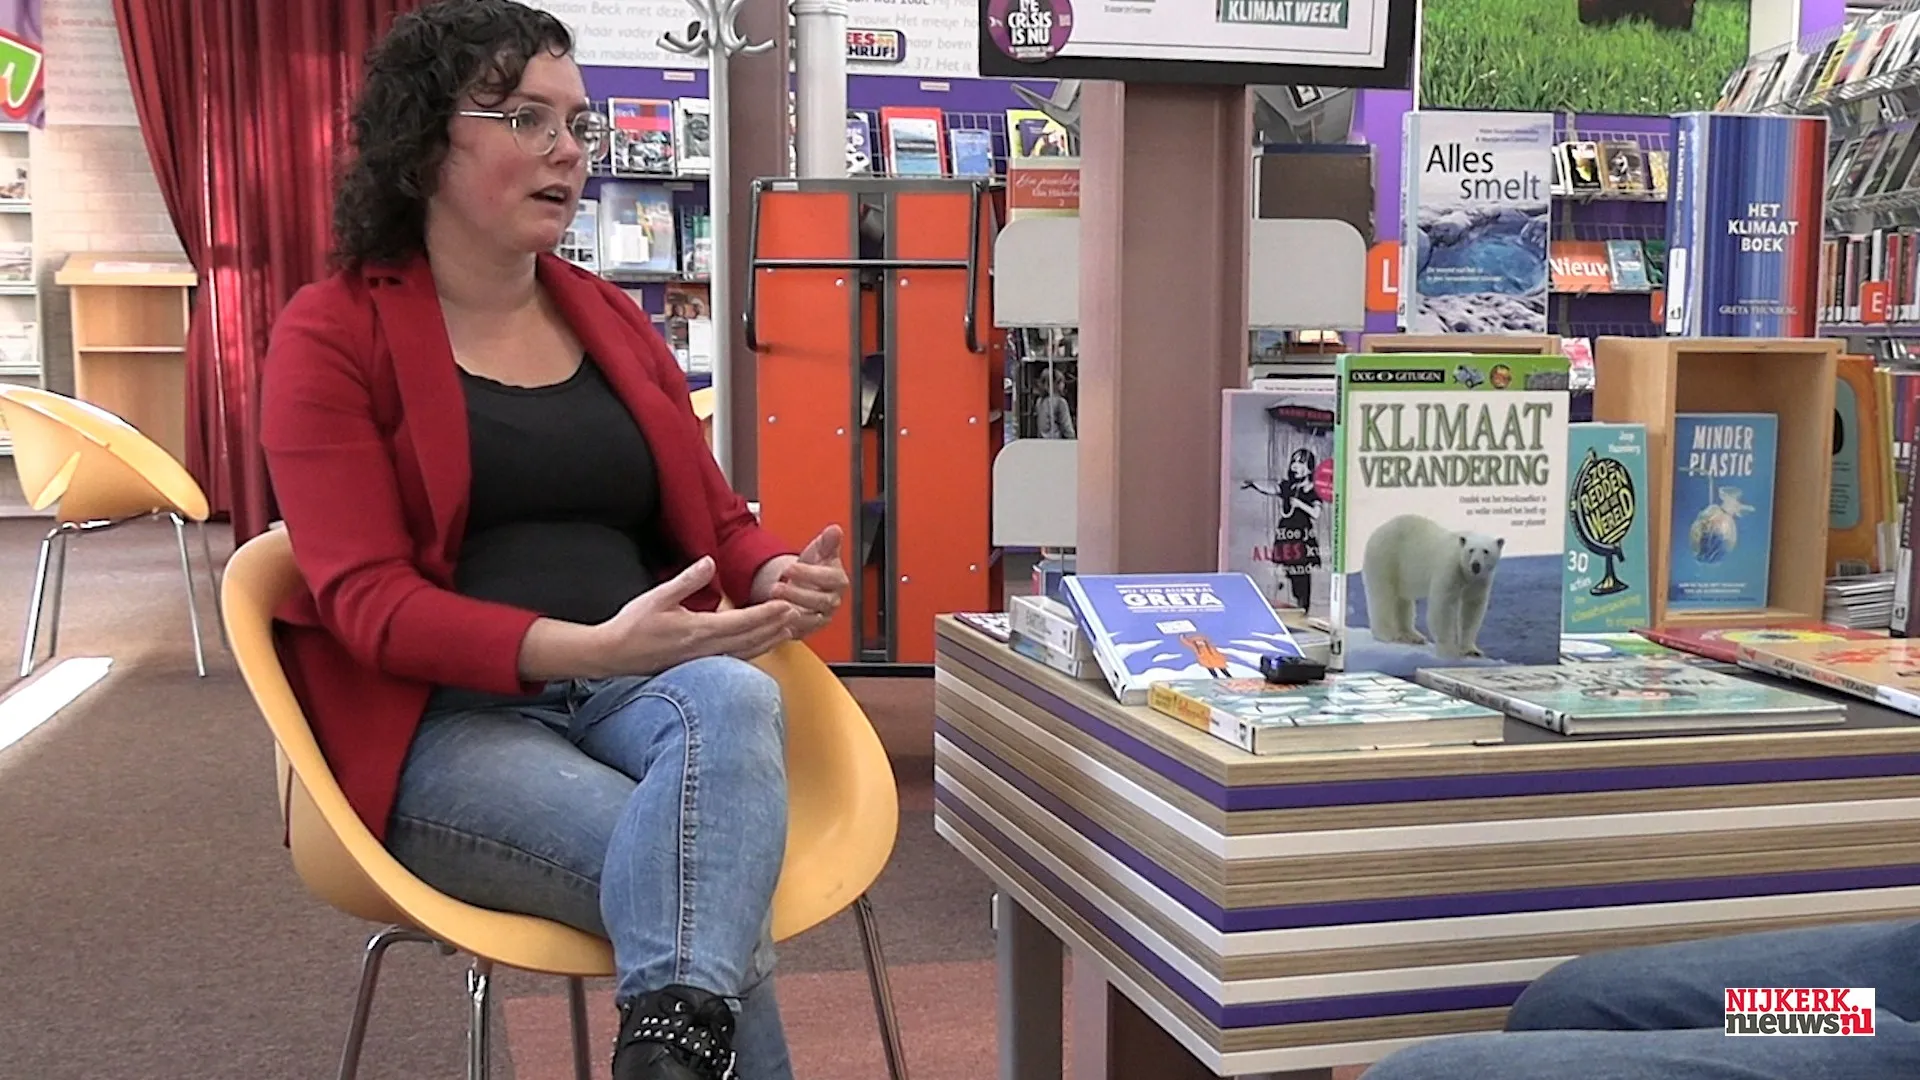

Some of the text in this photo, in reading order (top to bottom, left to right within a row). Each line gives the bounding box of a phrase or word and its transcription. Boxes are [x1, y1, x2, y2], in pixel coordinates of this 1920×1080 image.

[591, 1, 622, 16] Beck
[626, 4, 651, 18] met
[656, 5, 687, 19] deze
[895, 13, 918, 27] Het
[1007, 11, 1053, 29] CRISIS
[583, 24, 613, 38] haar
[846, 32, 876, 46] EES
[1011, 28, 1051, 46] IS NU
[937, 36, 972, 50] boven
[847, 46, 896, 59] HRIJF!
[936, 58, 960, 72] Het
[1425, 143, 1495, 174] Alles
[1459, 170, 1542, 200] smelt
[1747, 203, 1781, 218] HET
[1727, 219, 1799, 236] KLIMAAT
[1740, 237, 1784, 252] BOEK
[1382, 259, 1398, 293] L
[1718, 304, 1748, 315] GRETA
[1871, 291, 1885, 313] E
[1395, 371, 1442, 382] GETUIGEN
[1359, 402, 1553, 452] KLIMAAT
[1692, 424, 1754, 450] MINDER
[1358, 453, 1550, 488] VERANDERING
[1588, 460, 1608, 484] ZO
[1688, 451, 1754, 477] PLASTIC
[1580, 466, 1629, 514] REDDEN
[1585, 486, 1635, 541] WERELD
[1275, 528, 1302, 540] Hoe
[1253, 543, 1303, 562] ALLES
[1567, 549, 1589, 573] 30
[1122, 592, 1224, 608] GRETA
